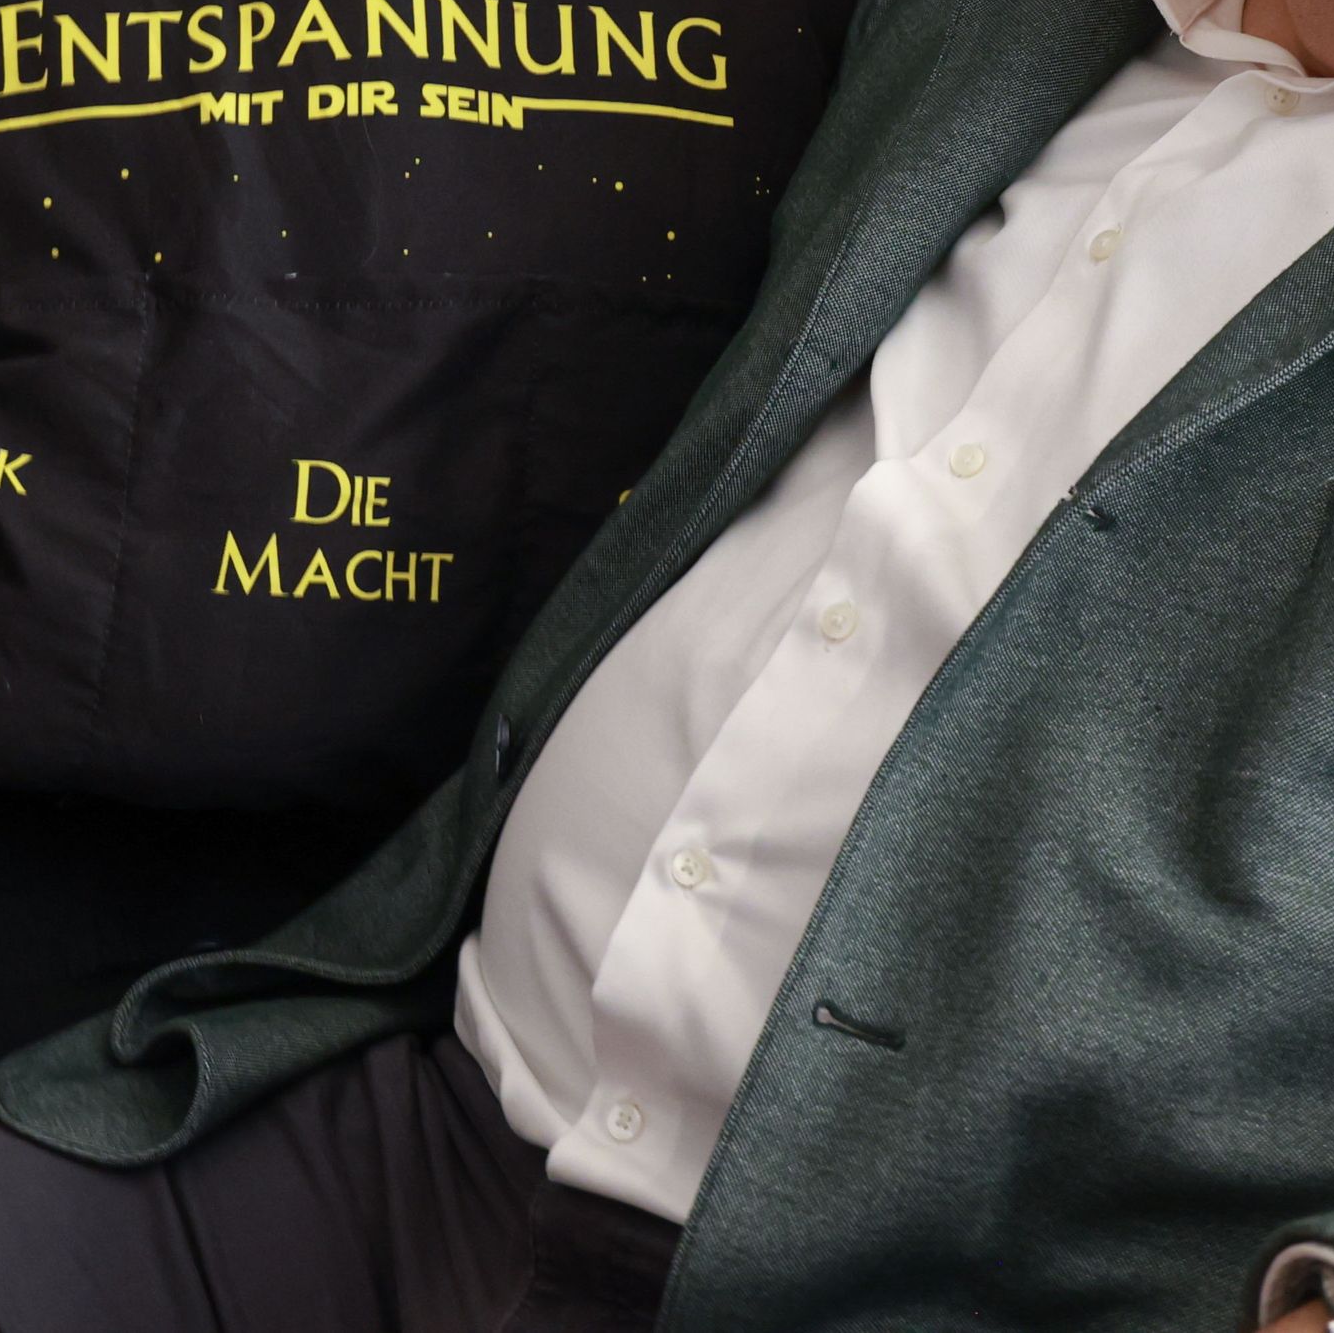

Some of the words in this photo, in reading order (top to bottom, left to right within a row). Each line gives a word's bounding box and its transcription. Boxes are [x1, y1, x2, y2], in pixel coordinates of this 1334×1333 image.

[199, 89, 284, 127] MIT
[307, 81, 399, 121] DIR
[419, 82, 524, 130] SEIN
